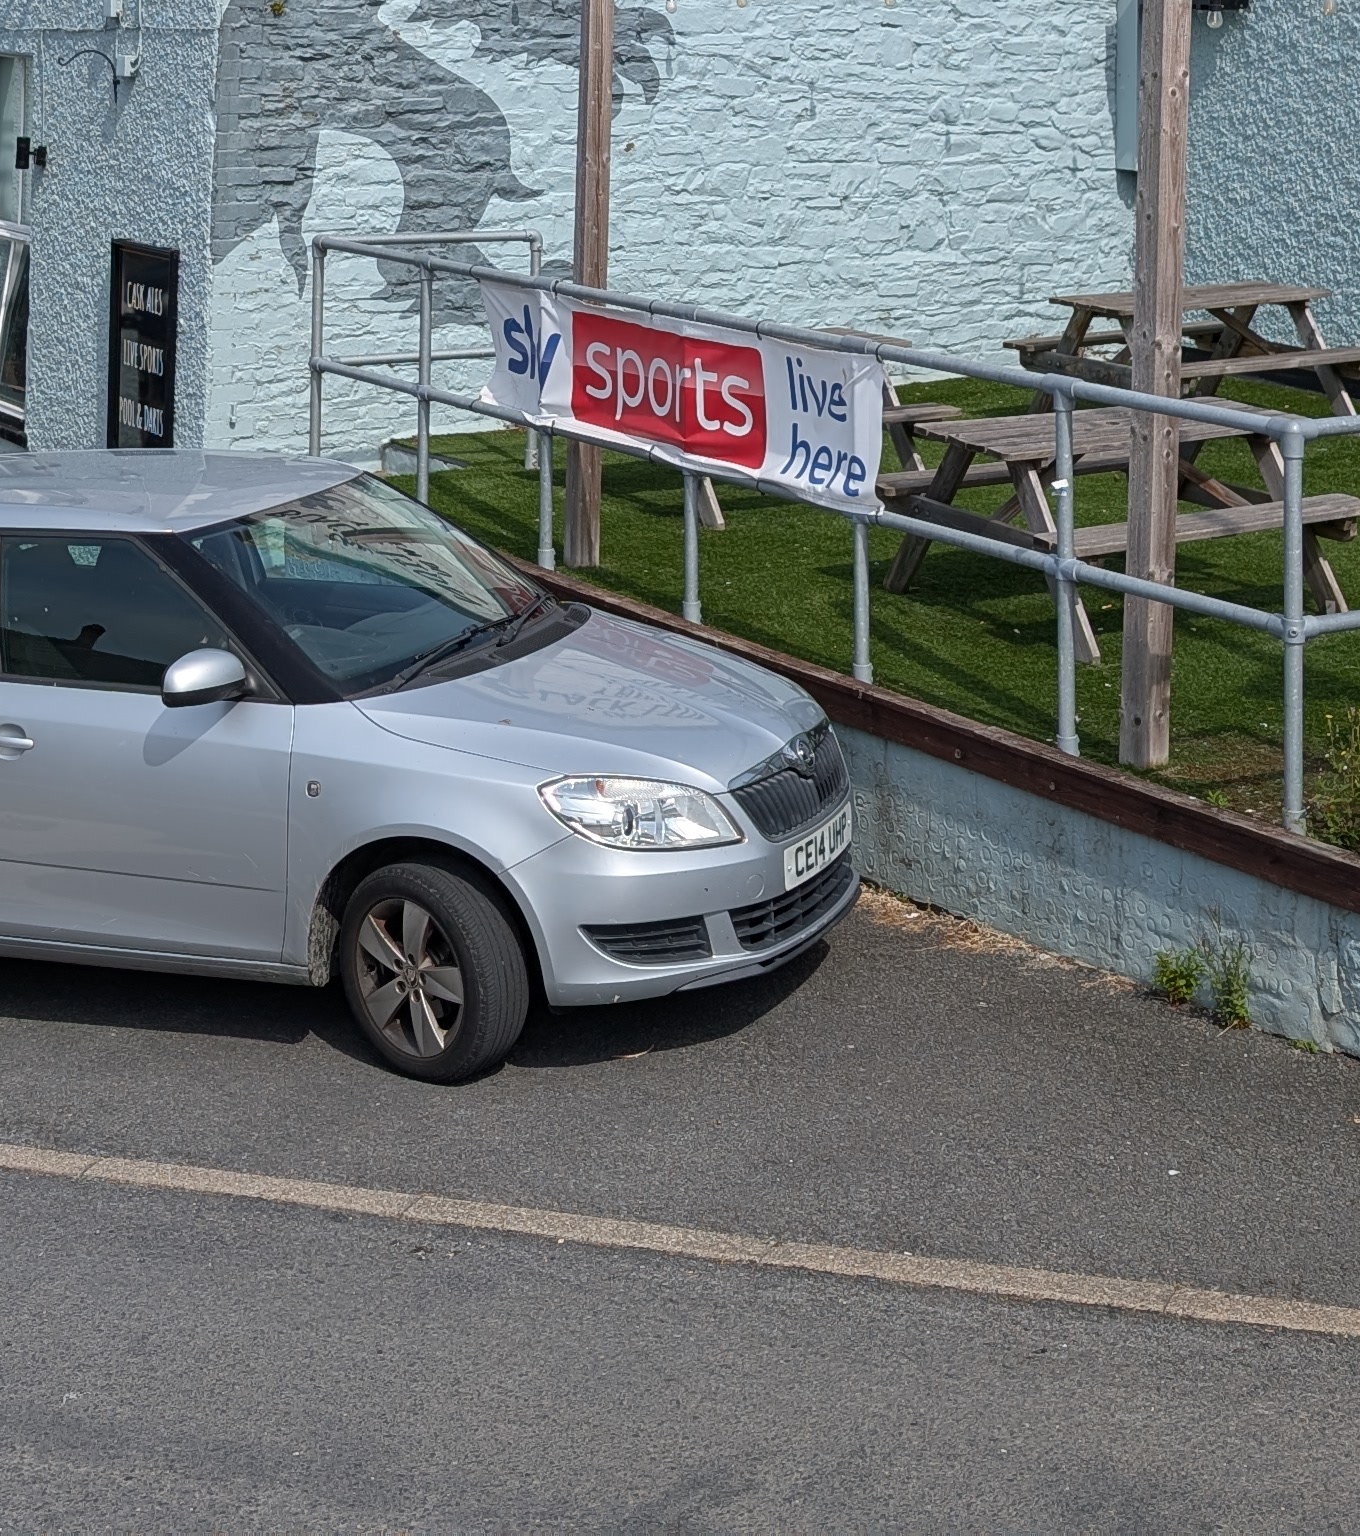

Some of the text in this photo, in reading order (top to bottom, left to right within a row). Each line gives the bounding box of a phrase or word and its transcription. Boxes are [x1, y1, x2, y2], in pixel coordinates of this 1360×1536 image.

[127, 281, 163, 316] CASK ALES
[123, 338, 164, 376] LIVE SPORTS
[585, 341, 754, 437] sports
[785, 356, 848, 423] live
[119, 396, 164, 437] POOL & DARTS
[780, 423, 867, 498] here
[794, 811, 847, 878] CE14 UHP
